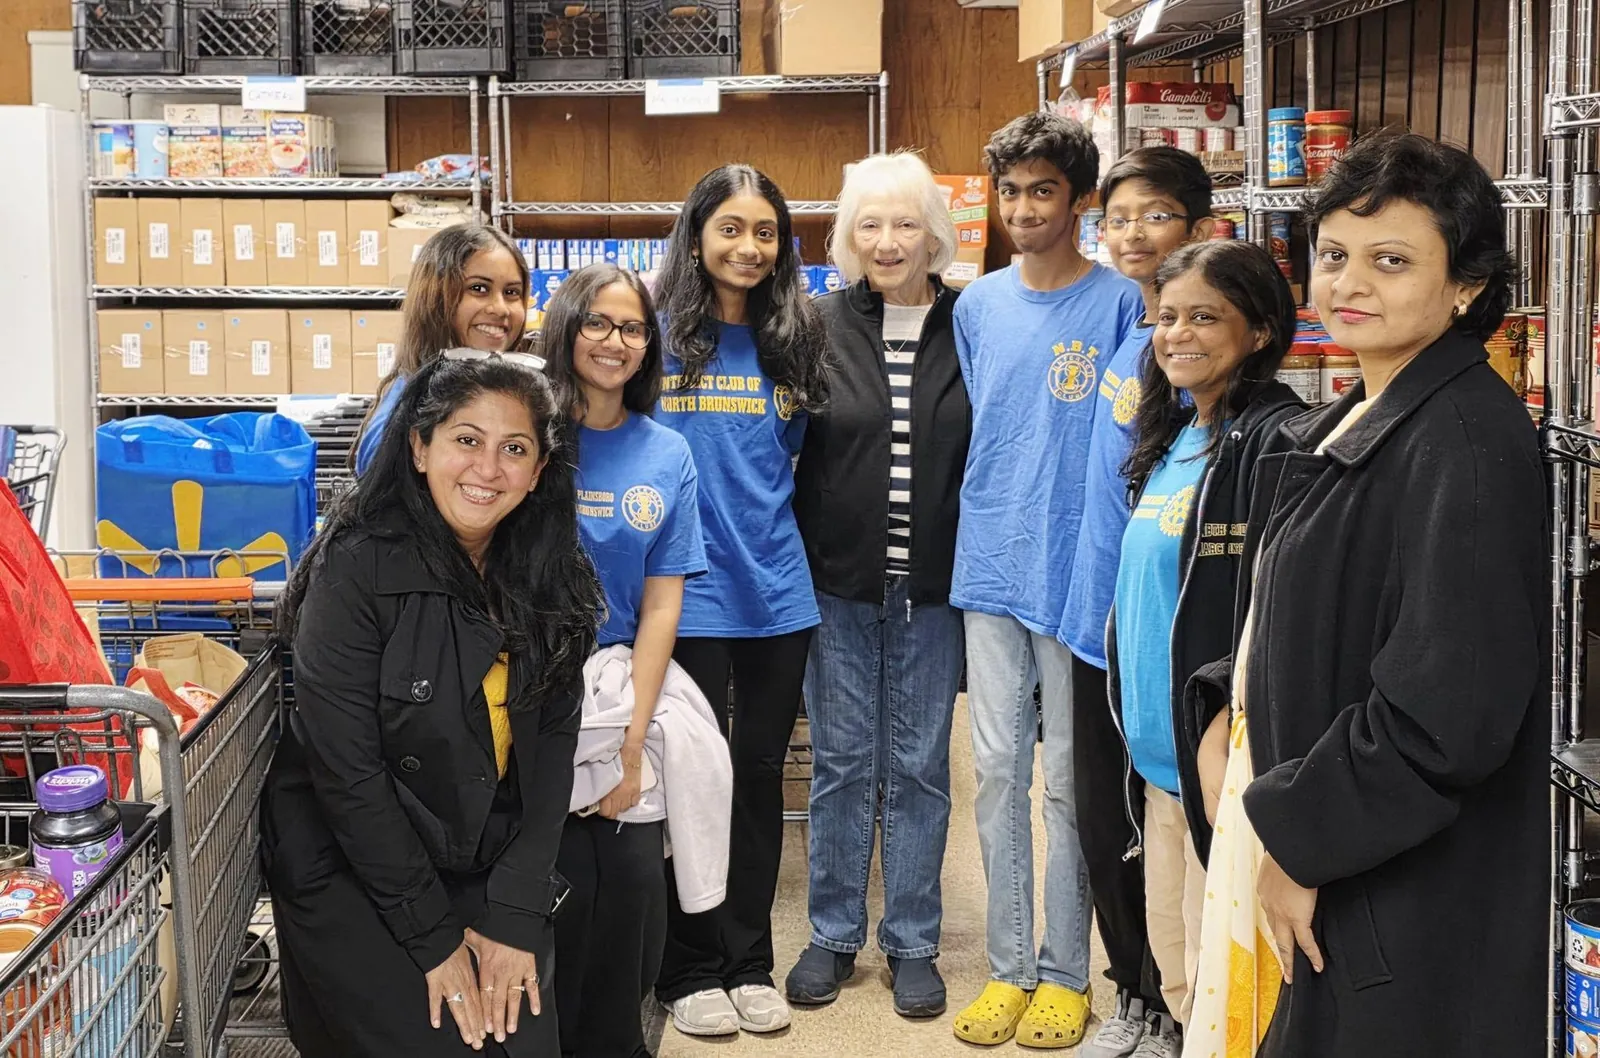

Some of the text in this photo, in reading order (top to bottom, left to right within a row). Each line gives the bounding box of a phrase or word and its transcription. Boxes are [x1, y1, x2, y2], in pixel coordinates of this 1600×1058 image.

[1160, 88, 1212, 104] Campbell's
[965, 177, 982, 188] 24
[716, 375, 745, 391] CLUB
[747, 376, 761, 391] OF
[660, 396, 766, 414] NORTH BRUNSWICK
